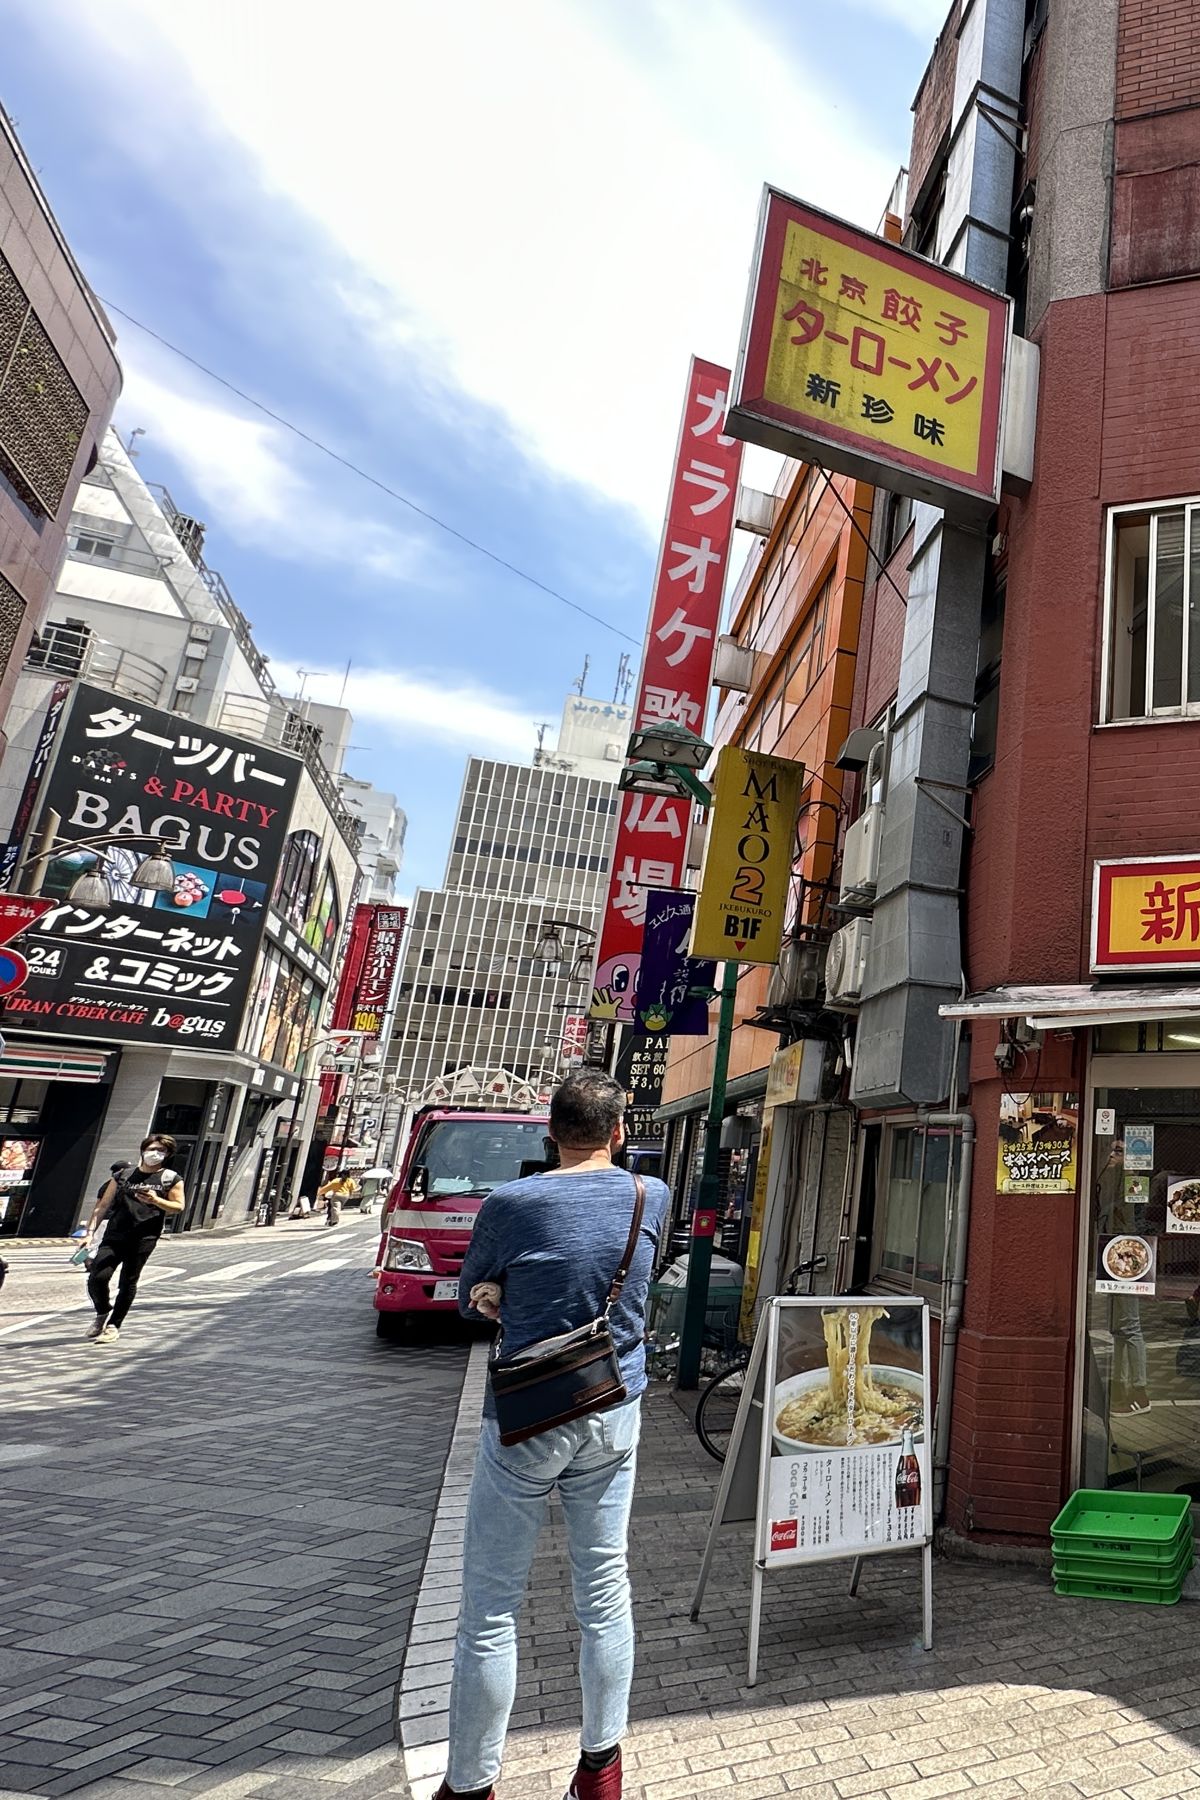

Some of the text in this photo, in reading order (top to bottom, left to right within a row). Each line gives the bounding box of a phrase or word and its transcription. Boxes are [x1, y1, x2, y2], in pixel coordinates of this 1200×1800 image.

[799, 256, 969, 347] 北京餃子
[782, 299, 978, 405] ターローメン
[804, 372, 946, 447] 新珍味
[71, 754, 137, 781] DARTS
[85, 707, 287, 787] ダーツバー
[93, 774, 112, 784] BAR
[143, 775, 279, 829] & PARTY
[68, 789, 261, 870] BAGUS
[40, 904, 242, 960] インターネット
[723, 914, 762, 941] B1F
[28, 946, 61, 968] 24
[84, 956, 234, 996] &コミック
[365, 930, 397, 1001] 情熱ホルモン
[56, 1002, 107, 1021] CYBER
[109, 1008, 148, 1026] CAFE
[152, 1007, 226, 1035] b@gus
[630, 1064, 651, 1076] SET
[788, 1462, 801, 1516] Coca-Cola
